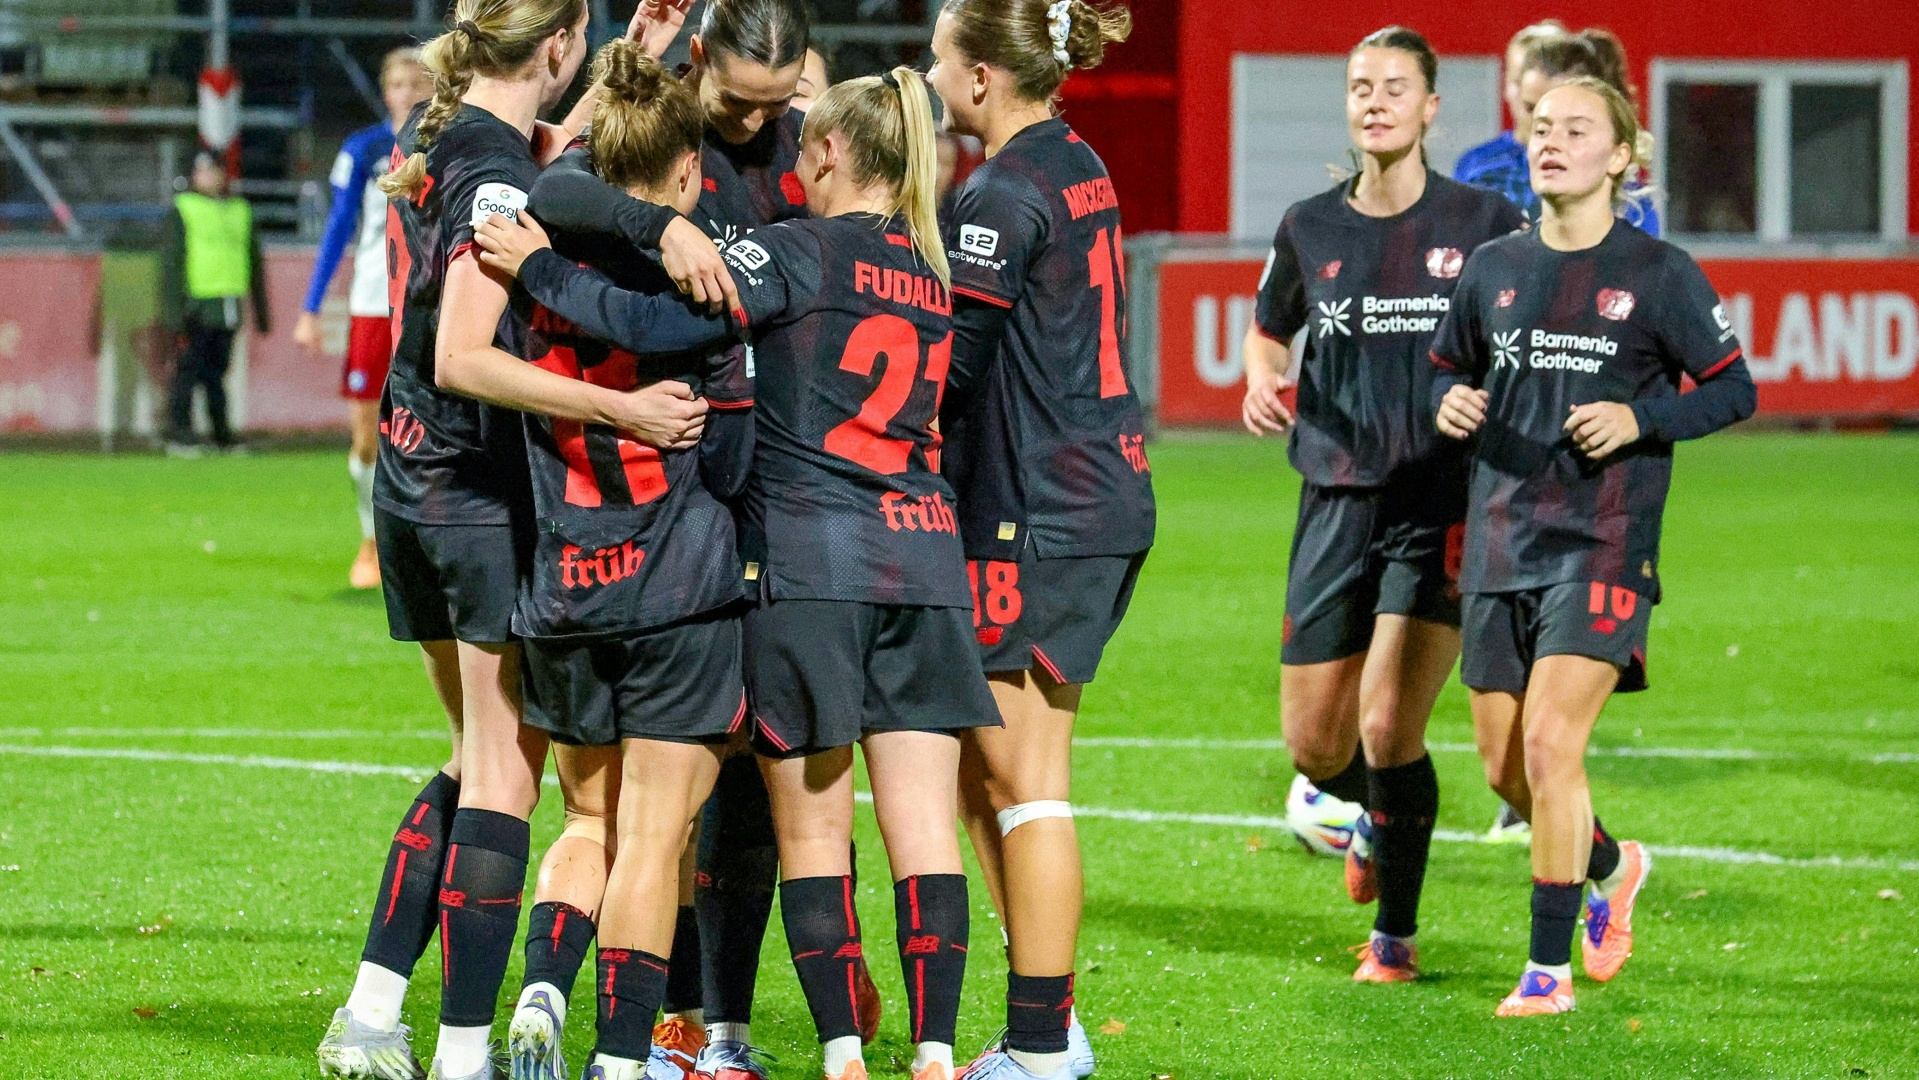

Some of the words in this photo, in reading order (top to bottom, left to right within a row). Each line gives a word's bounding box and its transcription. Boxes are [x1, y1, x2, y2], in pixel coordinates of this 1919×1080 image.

[477, 197, 519, 219] Googl
[733, 244, 764, 266] s2
[964, 233, 994, 250] s2
[1087, 224, 1126, 399] 1
[1362, 293, 1451, 314] Barmenia
[1361, 315, 1438, 334] Gothaer
[1732, 291, 1919, 382] LAND
[1530, 328, 1619, 357] Barmenia
[1529, 350, 1604, 374] Gothaer
[823, 313, 955, 475] 21
[878, 491, 957, 540] früh
[557, 539, 647, 589] früh
[966, 559, 1024, 628] 18
